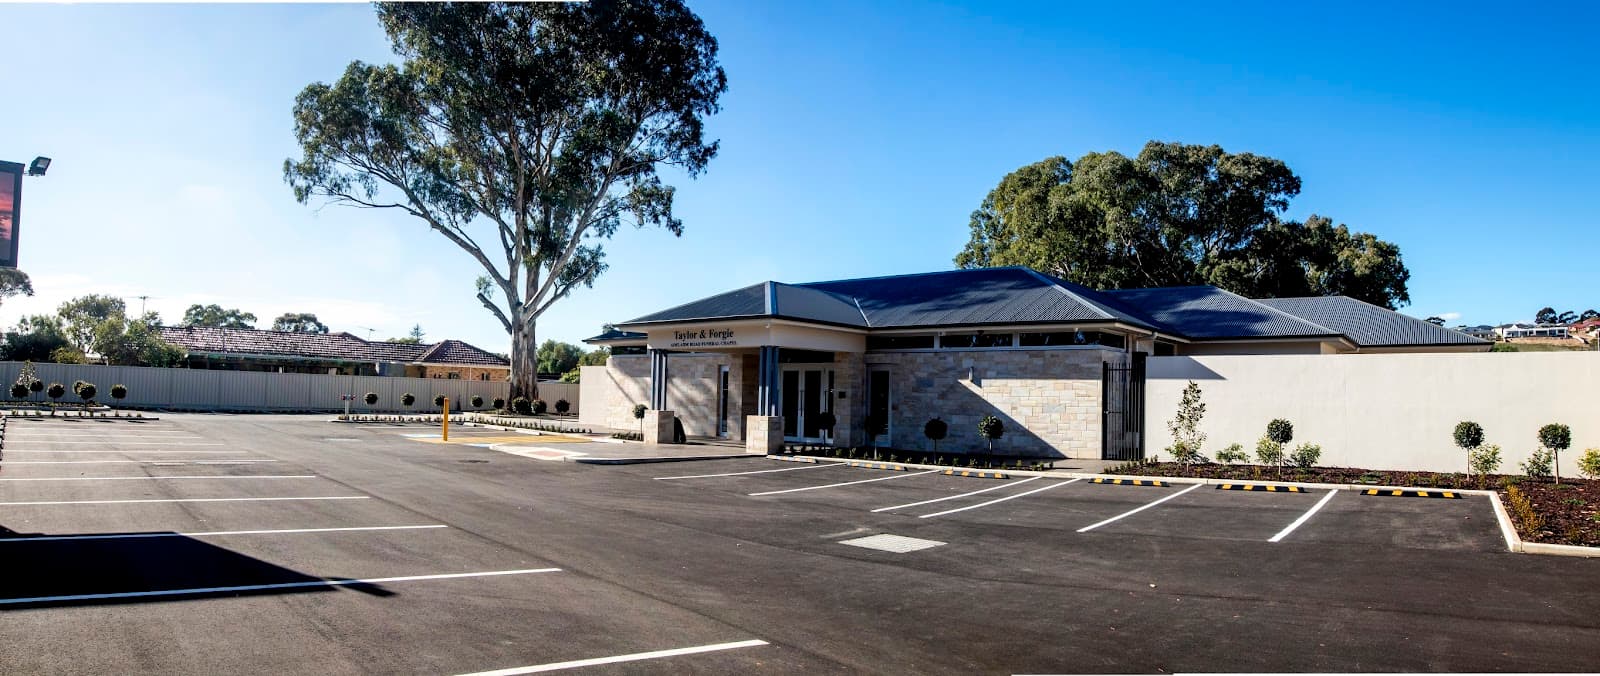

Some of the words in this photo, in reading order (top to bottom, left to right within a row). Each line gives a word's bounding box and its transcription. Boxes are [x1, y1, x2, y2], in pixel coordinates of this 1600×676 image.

[674, 330, 698, 341] Taylor
[699, 329, 706, 339] &
[709, 328, 734, 339] Forgie
